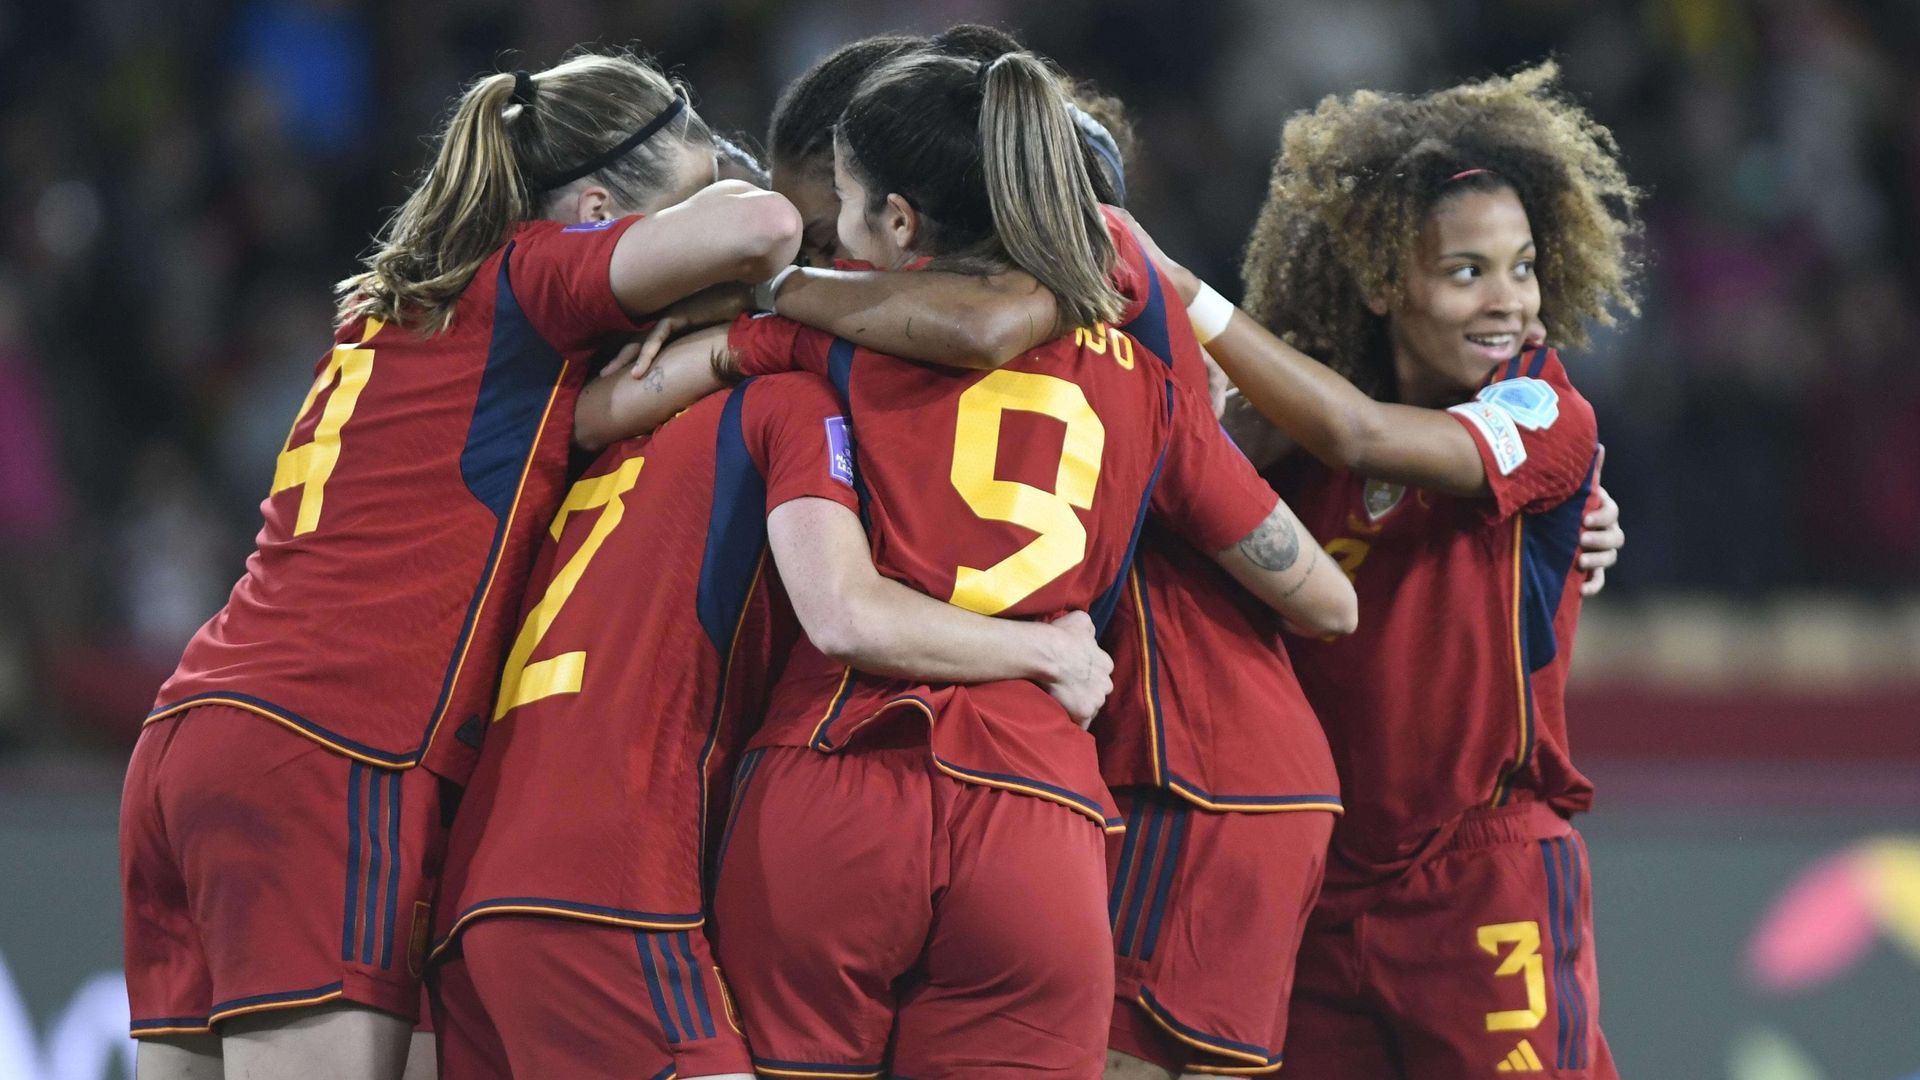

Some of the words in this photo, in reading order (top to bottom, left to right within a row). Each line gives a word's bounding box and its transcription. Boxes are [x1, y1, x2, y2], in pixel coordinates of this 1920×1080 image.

[270, 316, 386, 537] 4
[949, 369, 1105, 616] 9
[493, 456, 645, 722] 2
[1477, 920, 1547, 1032] 3
